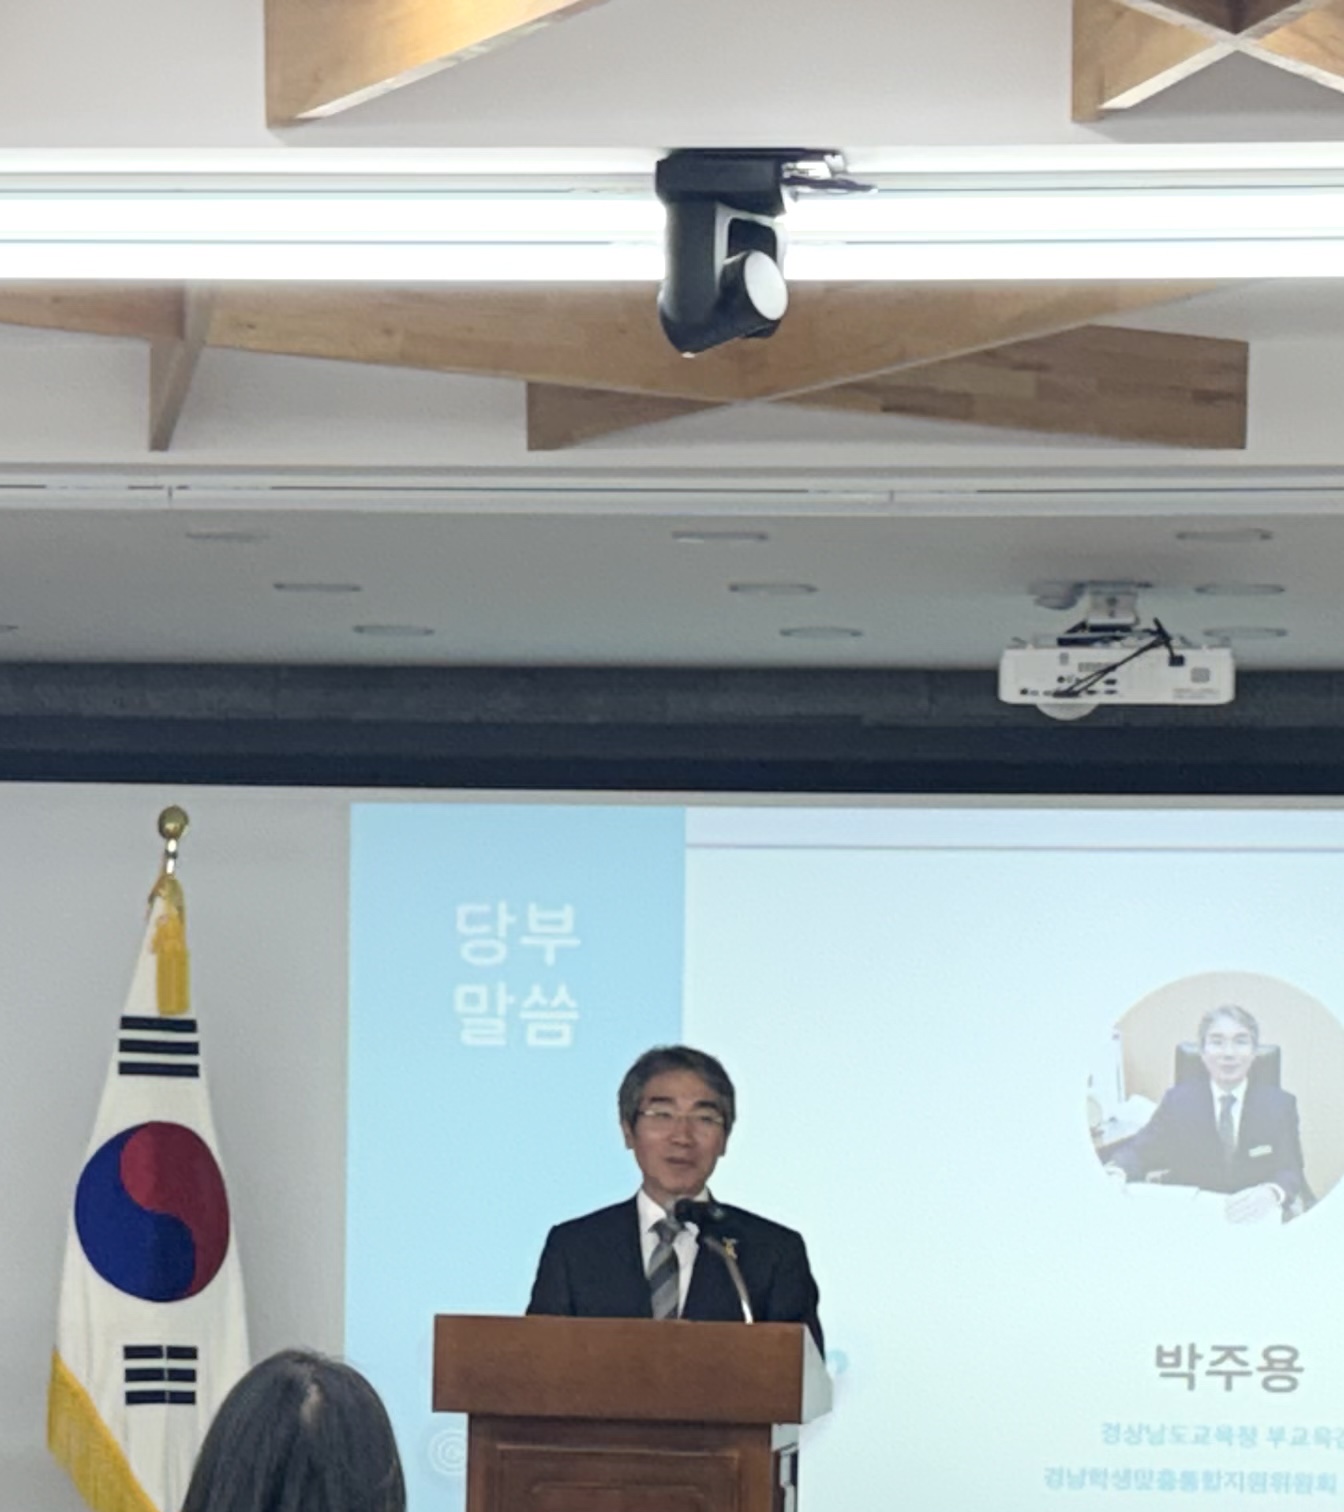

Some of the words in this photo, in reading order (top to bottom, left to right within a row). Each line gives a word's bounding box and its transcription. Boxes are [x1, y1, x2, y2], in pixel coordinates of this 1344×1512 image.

[456, 901, 581, 966] 당부
[453, 981, 580, 1048] 말씀
[1155, 1342, 1305, 1393] 박주용
